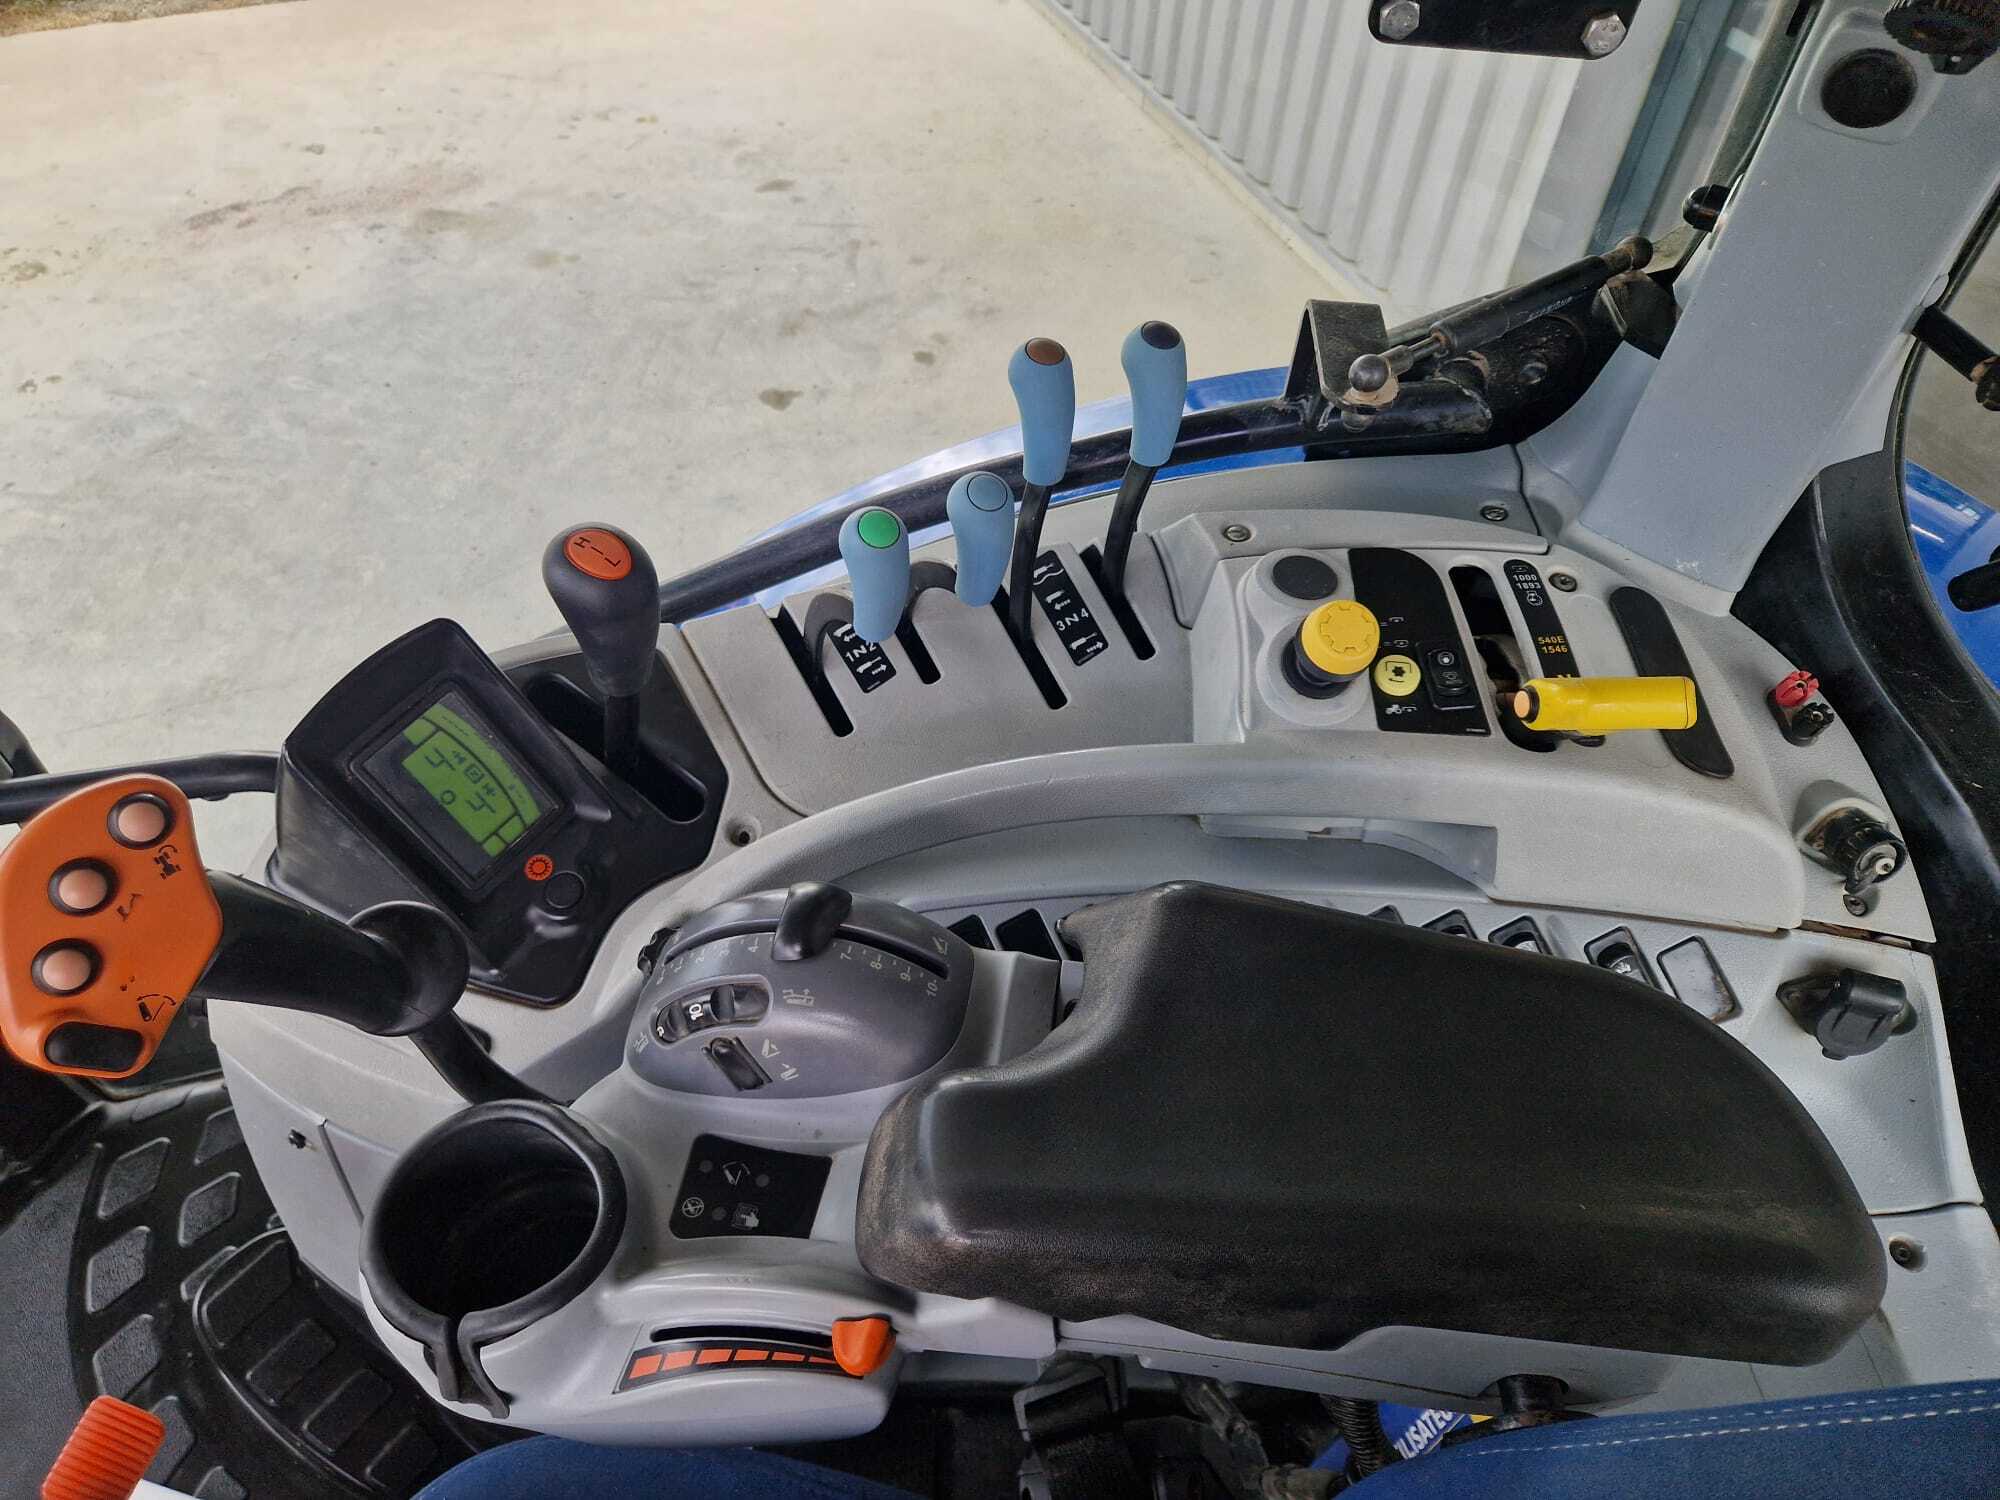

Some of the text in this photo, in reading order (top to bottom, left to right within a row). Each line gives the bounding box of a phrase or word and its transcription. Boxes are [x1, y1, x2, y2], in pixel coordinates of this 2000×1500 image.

[1512, 574, 1538, 582] 1000
[1537, 636, 1566, 645] 540E
[1541, 646, 1568, 655] 1546
[688, 1003, 704, 1022] 10
